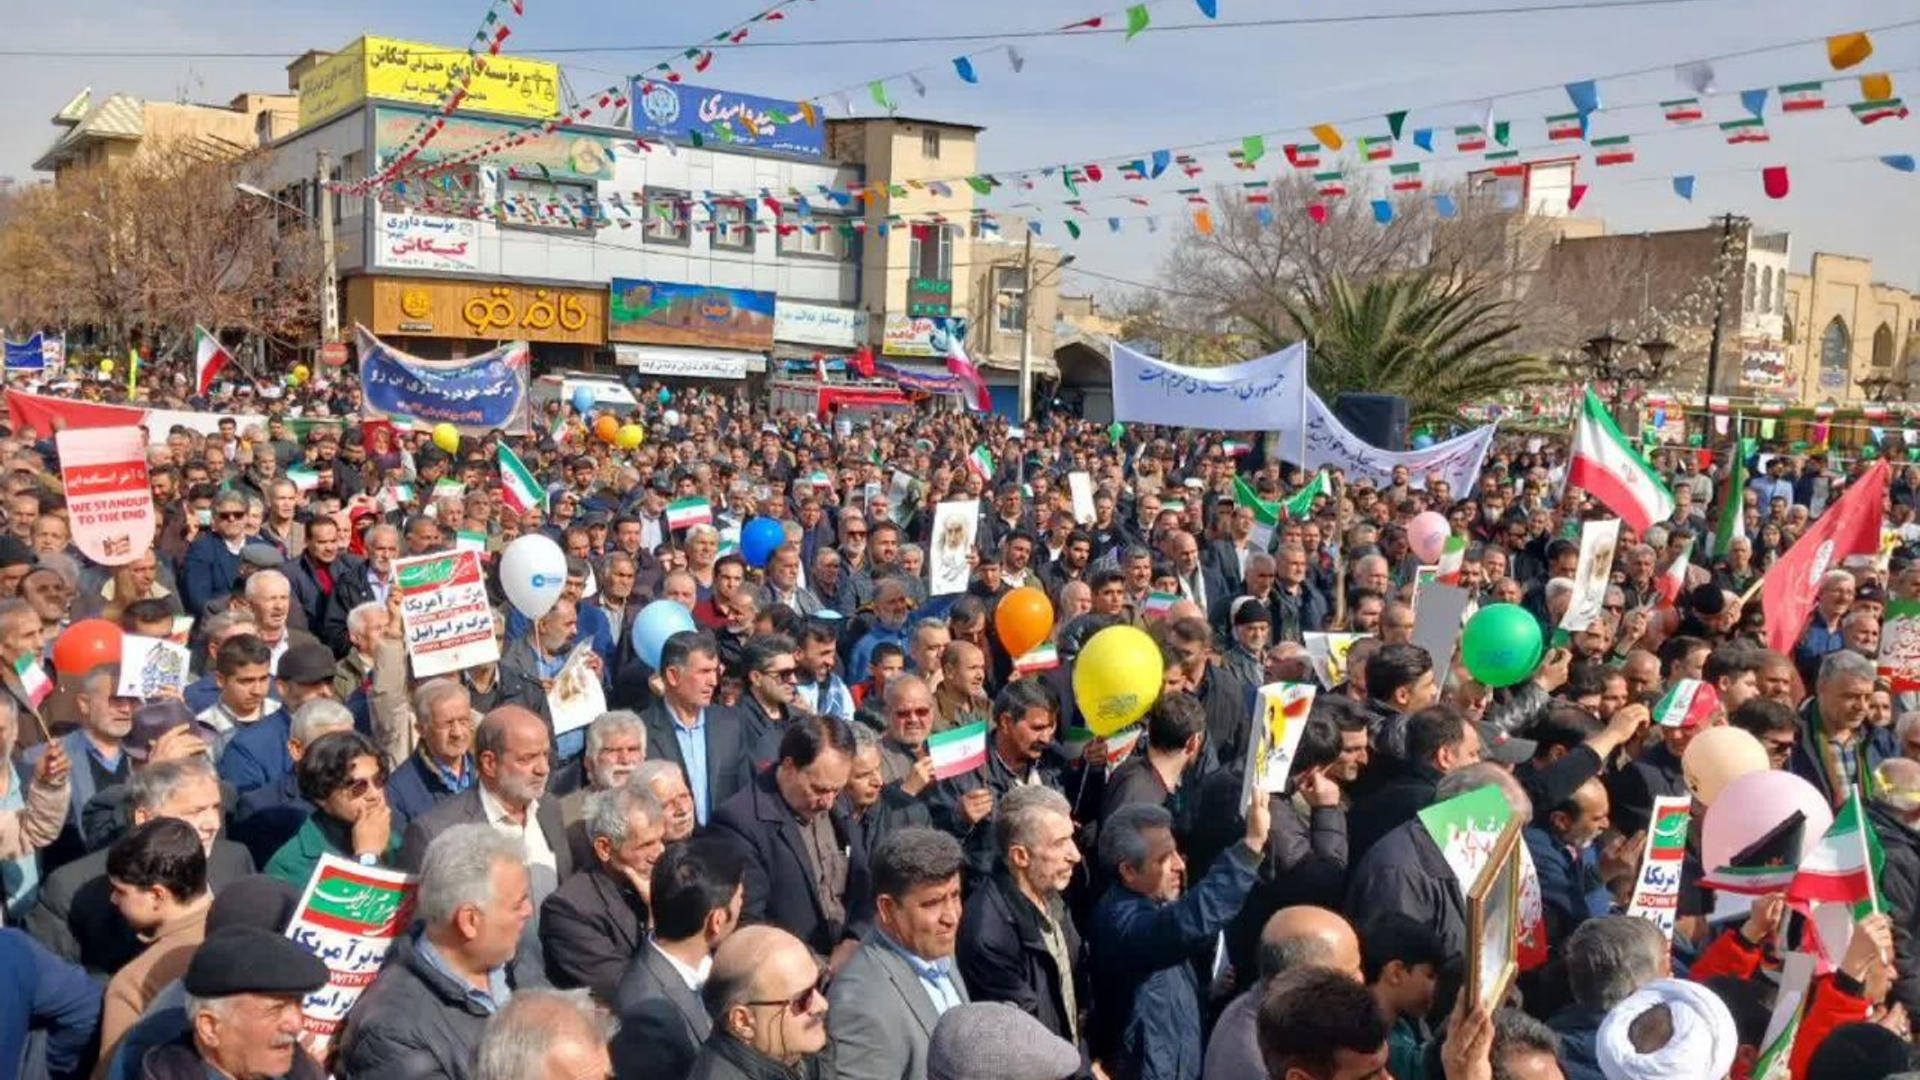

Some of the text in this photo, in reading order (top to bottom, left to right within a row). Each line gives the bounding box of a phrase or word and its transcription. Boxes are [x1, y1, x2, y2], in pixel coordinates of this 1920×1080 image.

[387, 216, 420, 230] داوری
[71, 501, 91, 513] WE
[78, 508, 147, 526] TO THE END
[302, 1020, 337, 1034] WITH
